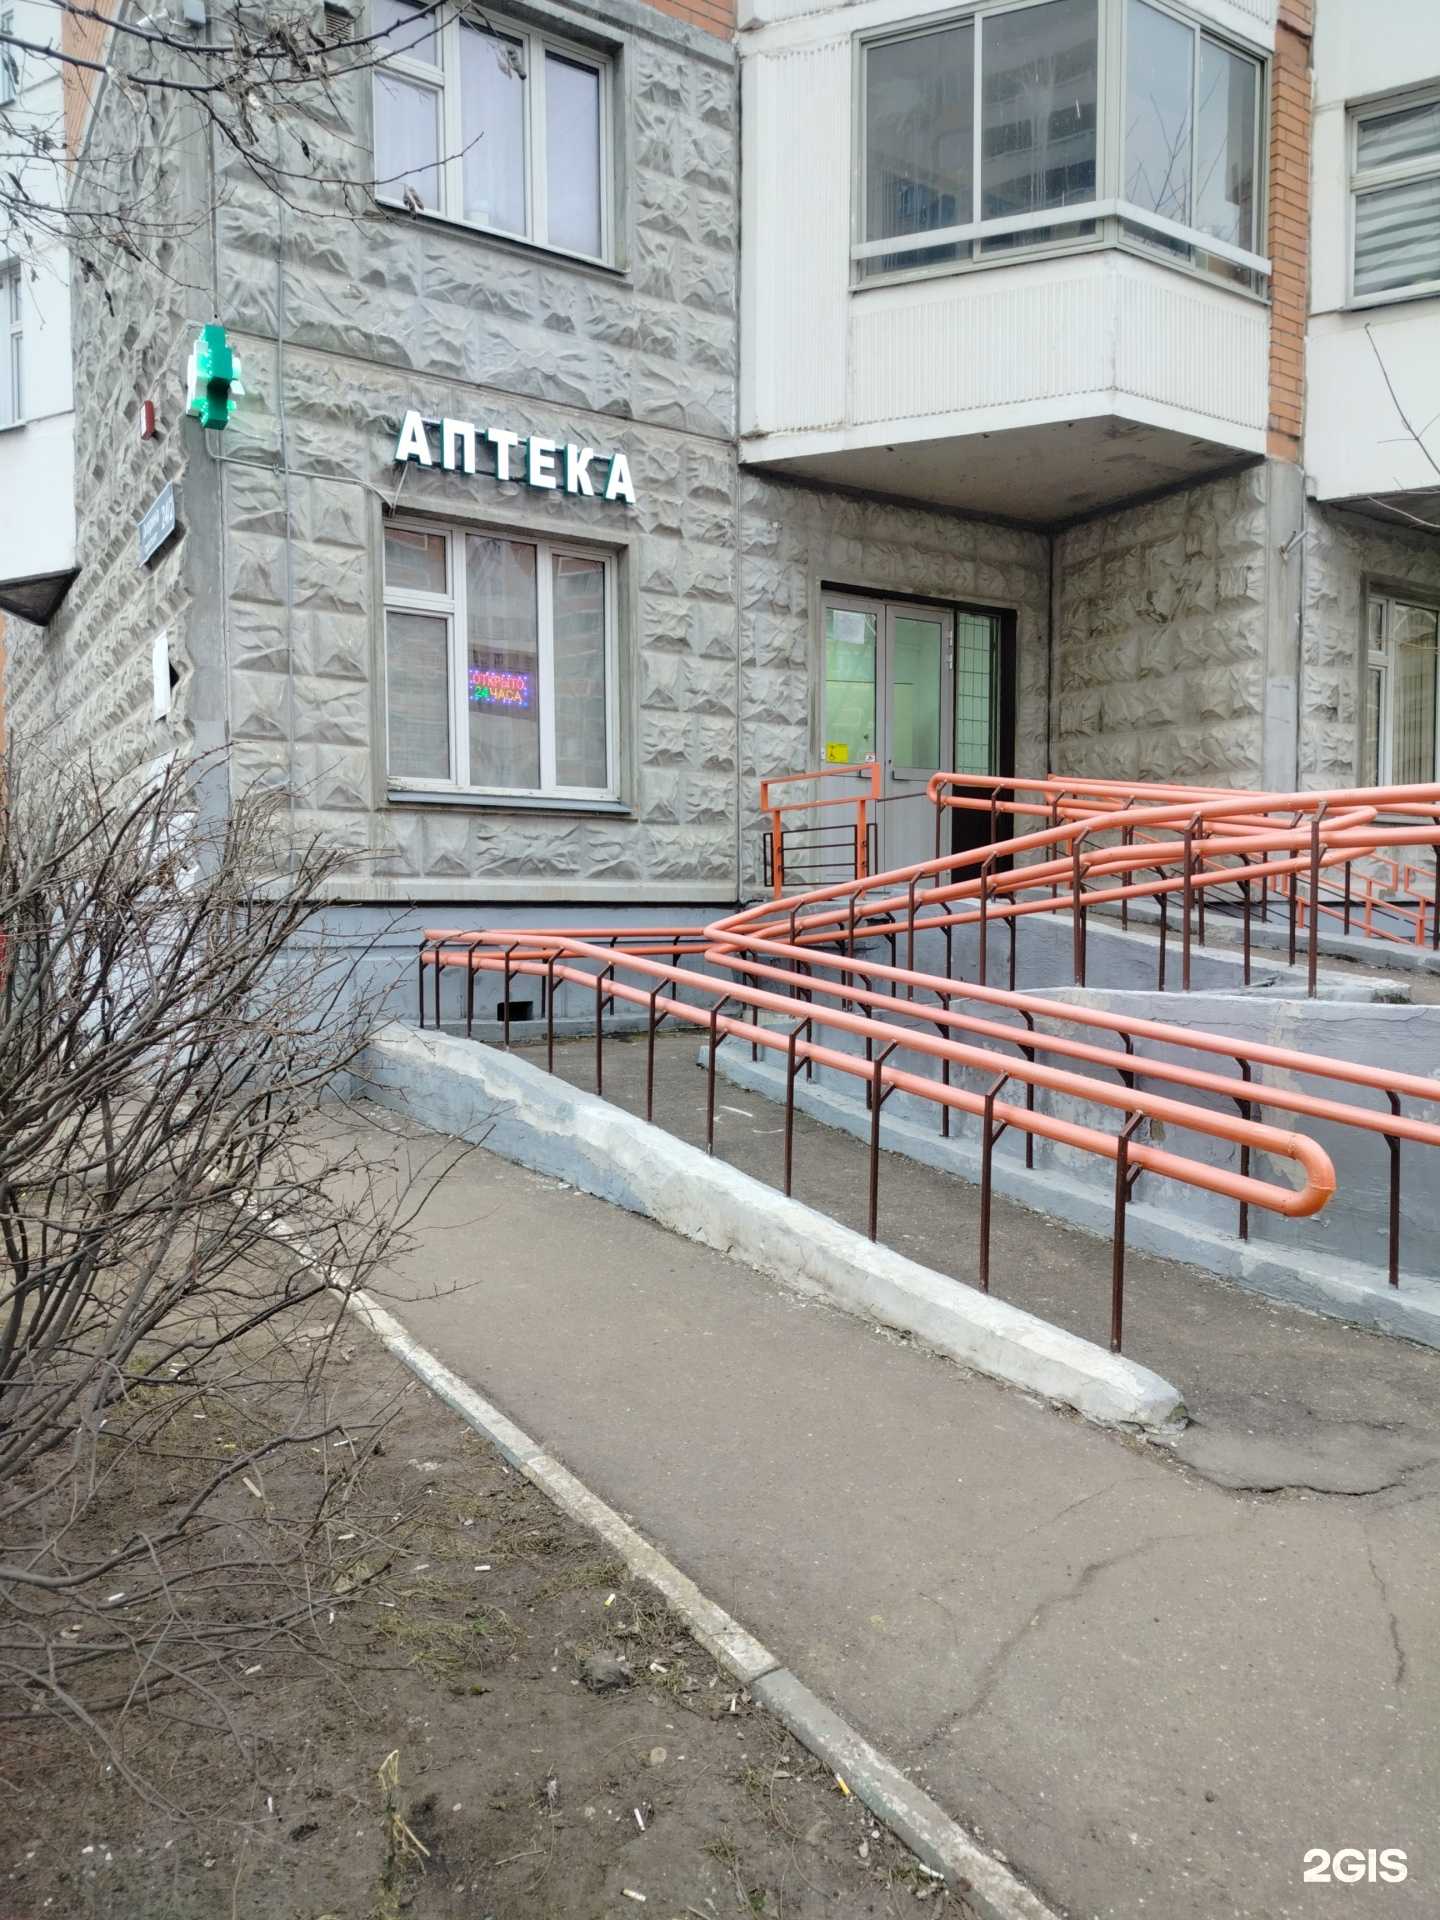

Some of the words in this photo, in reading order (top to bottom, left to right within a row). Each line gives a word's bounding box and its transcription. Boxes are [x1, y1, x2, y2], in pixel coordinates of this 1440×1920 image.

[394, 409, 637, 504] АПТЕКА
[472, 672, 525, 689] ОТКРЫТО
[474, 686, 490, 699] 24
[489, 687, 522, 702] ЧАСА
